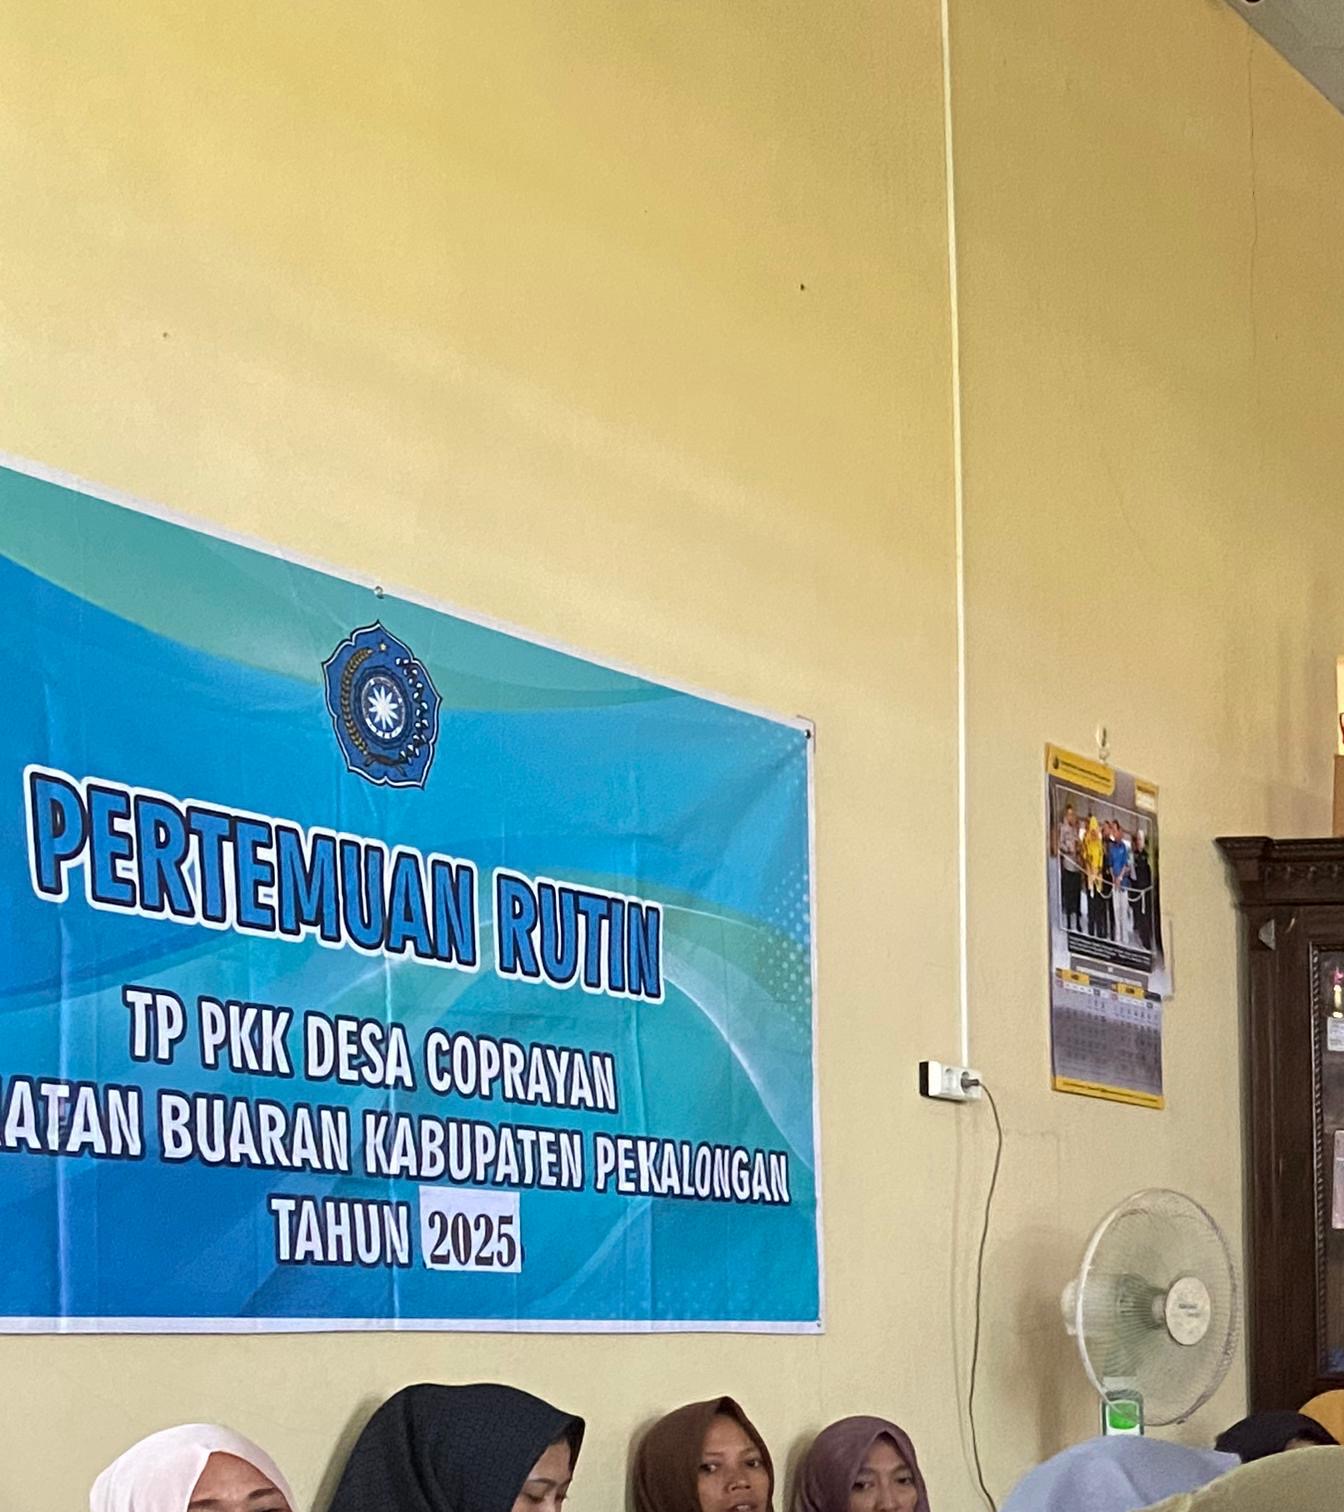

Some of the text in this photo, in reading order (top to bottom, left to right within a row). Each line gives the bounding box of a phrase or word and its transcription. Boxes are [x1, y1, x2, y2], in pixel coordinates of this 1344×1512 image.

[25, 766, 664, 1002] PERTEMUAN RUTIN
[126, 989, 617, 1111] TP PKK DESA COPRAYAN
[0, 1079, 790, 1203] ATAN BUARAN KABUPATEN PEKALONGAN
[270, 1197, 518, 1267] TAHUN 2025
